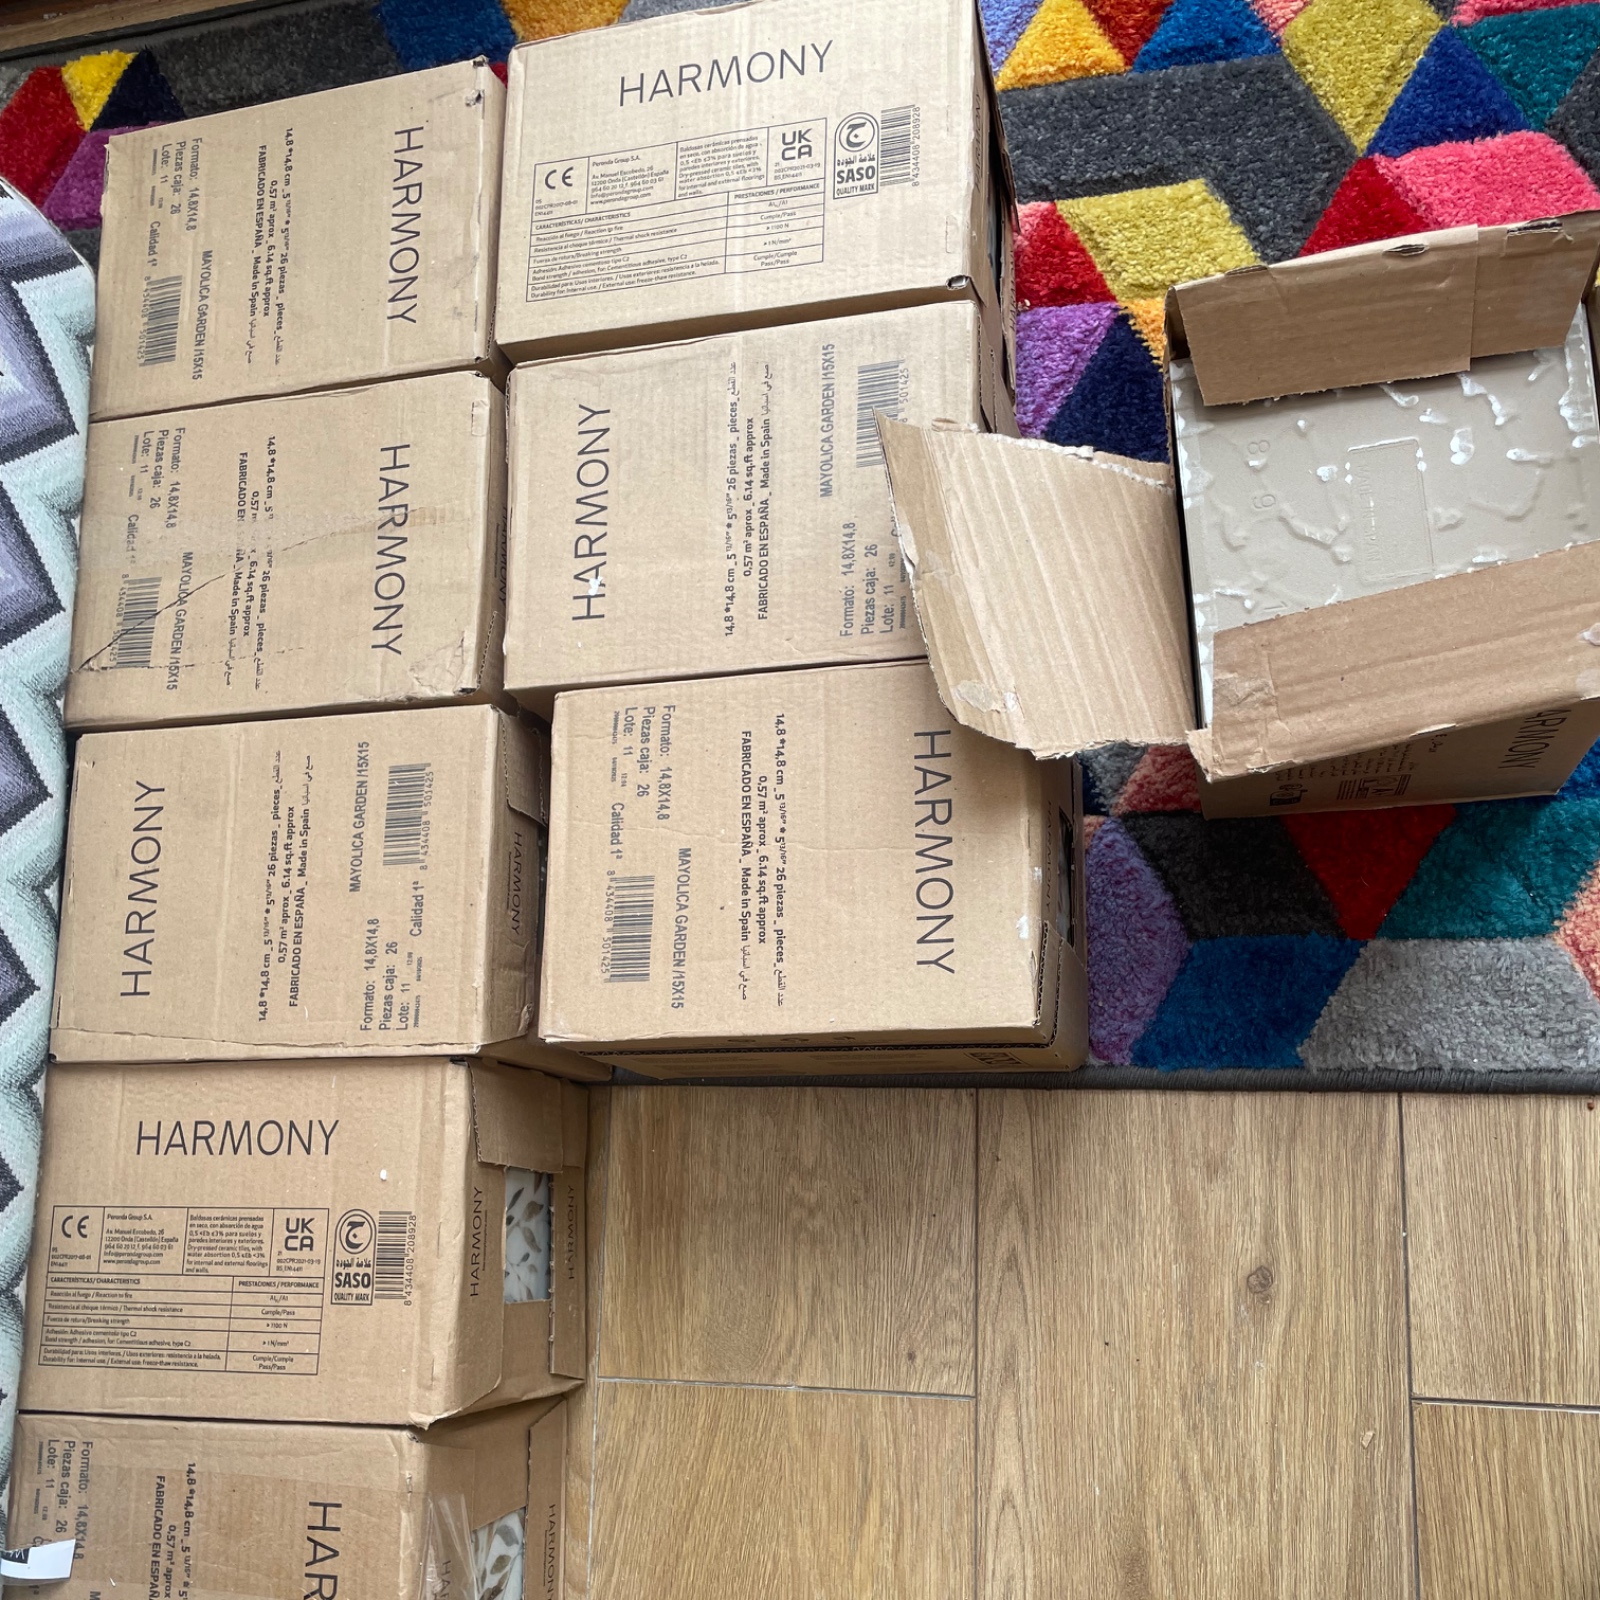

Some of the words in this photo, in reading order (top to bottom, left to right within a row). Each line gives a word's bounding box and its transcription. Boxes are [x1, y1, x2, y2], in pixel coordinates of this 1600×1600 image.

[619, 40, 833, 106] HARMONY
[836, 165, 875, 185] SASO
[386, 126, 424, 323] HARMONY
[819, 382, 834, 432] GARDEN
[746, 417, 756, 452] approx
[760, 418, 772, 447] Spain
[726, 443, 739, 474] piezas
[759, 460, 769, 488] Made
[819, 434, 833, 497] MAYOLICA
[571, 403, 610, 620] HARMONY
[745, 508, 754, 537] aprox
[757, 497, 769, 541] ESPAÑA
[370, 443, 410, 655] HARMONY
[757, 559, 768, 619] FABRICADO
[860, 597, 875, 634] Piezas
[622, 706, 638, 736] Lote:
[640, 706, 655, 744] Piezas
[659, 704, 676, 756] Formato:
[622, 745, 633, 755] 11
[636, 746, 652, 773] caja:
[741, 730, 751, 793] FABRICADO
[636, 783, 650, 797] 26
[654, 766, 672, 820] 14,8X14,8
[757, 775, 767, 798] 0,57
[776, 769, 783, 785] cm
[352, 780, 367, 828] GARDEN
[741, 794, 751, 810] EN
[286, 806, 295, 840] approx
[298, 808, 311, 837] Spain
[609, 802, 624, 845] Calidad
[741, 811, 753, 856] ESPAÑA
[755, 816, 766, 846] aprox
[268, 829, 278, 861] piezas
[283, 841, 294, 865] sq.ft
[296, 850, 307, 877] Made
[348, 831, 364, 892] MAYOLICA
[913, 729, 955, 974] HARMONY
[119, 780, 165, 996] HARMONY
[675, 847, 691, 912] MAYOLICA
[741, 867, 751, 896] Made
[755, 879, 768, 904] sq.ft
[776, 866, 786, 881] 26
[281, 895, 290, 924] aprox
[293, 886, 305, 929] ESPAÑA
[409, 894, 424, 937] Calidad
[603, 885, 615, 922] 434408
[741, 898, 751, 908] in
[773, 883, 786, 917] piezas
[672, 914, 688, 967] GARDEN
[738, 910, 751, 941] Spain
[755, 906, 765, 944] approx
[600, 937, 611, 973] 501425
[288, 947, 301, 1006] FABRICADO
[382, 964, 397, 991] caja:
[359, 980, 375, 1030] Formato:
[378, 993, 393, 1030] Piezas
[136, 1119, 339, 1156] HARMONY
[470, 1186, 483, 1297] HARMONY
[334, 1293, 354, 1301] QUALITY
[356, 1293, 370, 1301] MARK
[335, 1272, 371, 1288] SASO
[60, 1440, 75, 1478] Piezas
[152, 1475, 165, 1539] FABRICADO
[163, 1567, 172, 1597] aprox
